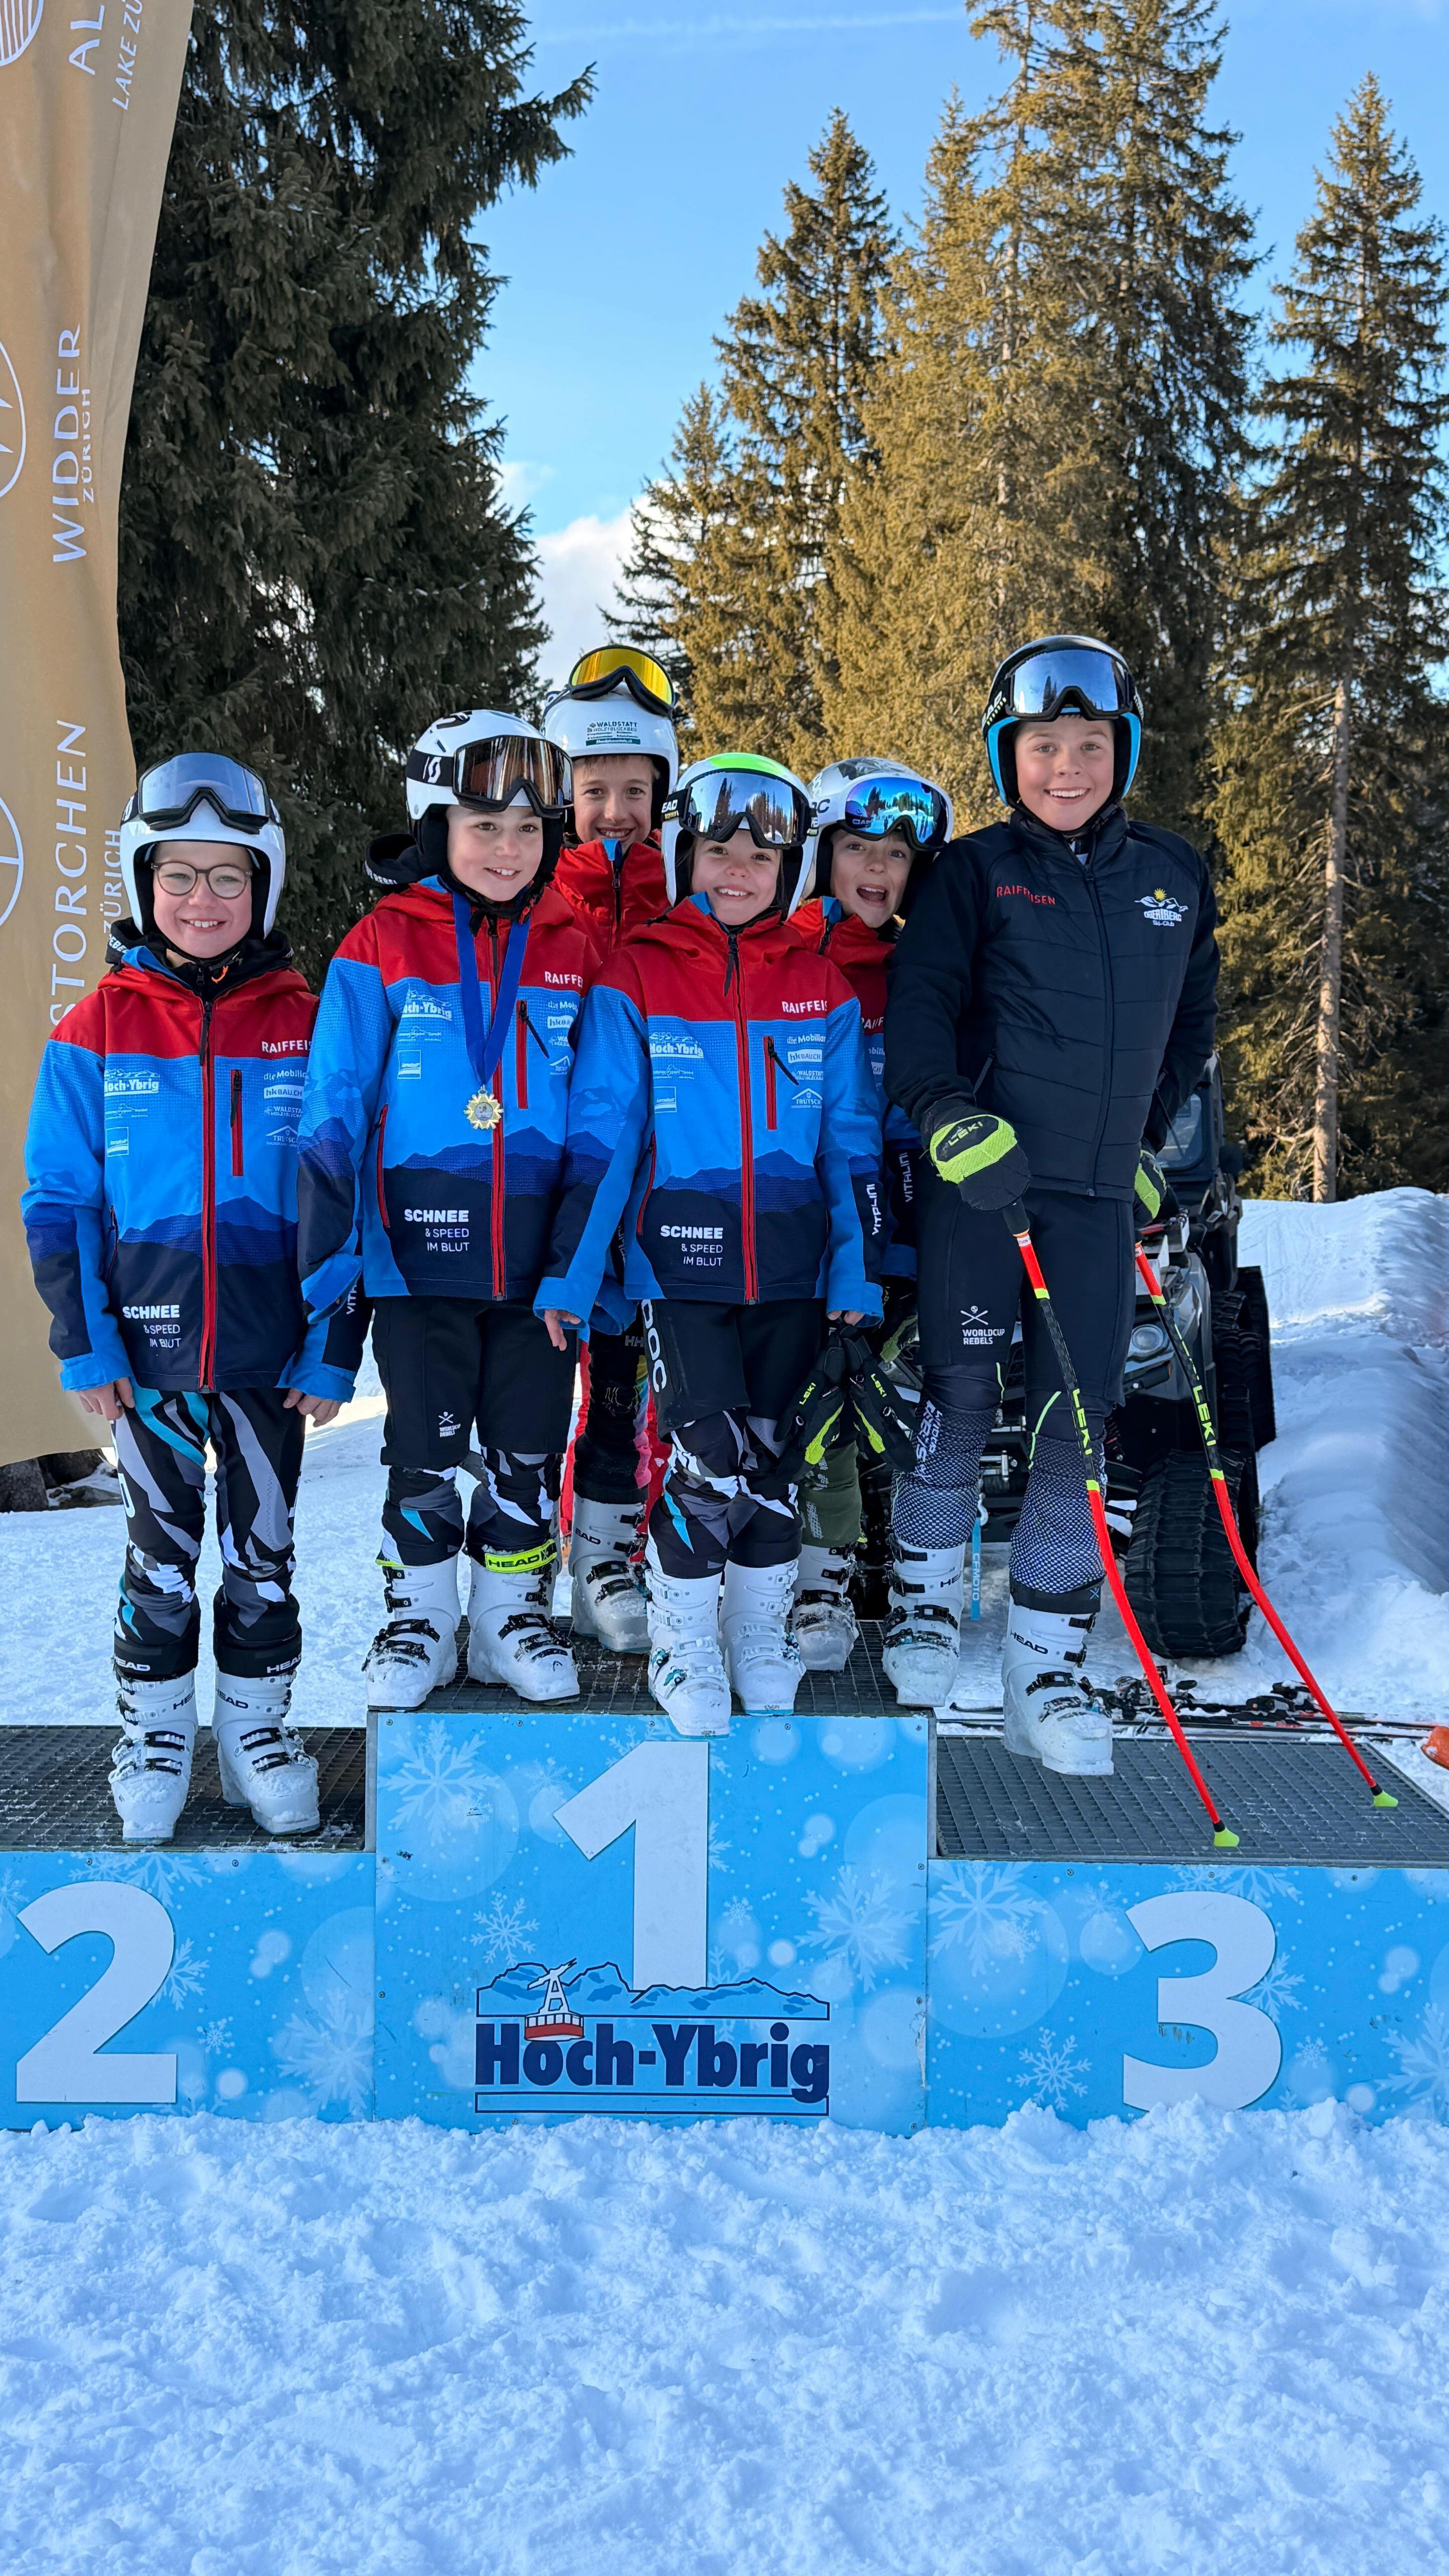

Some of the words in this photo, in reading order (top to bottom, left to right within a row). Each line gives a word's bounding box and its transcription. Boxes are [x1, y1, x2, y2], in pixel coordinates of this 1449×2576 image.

[112, 36, 137, 110] LAKE
[52, 324, 87, 562] WIDDER
[82, 389, 94, 503] ZÜRICH
[50, 719, 87, 1026] STORCHEN
[100, 830, 121, 933] ZÜRICH
[948, 1121, 983, 1146] LEKI
[404, 1209, 469, 1223] SCHNEE
[425, 1228, 431, 1237] &
[433, 1228, 469, 1238] SPEED
[660, 1225, 723, 1239] SCHNEE
[427, 1242, 438, 1251] IM
[441, 1242, 470, 1252] BLUT
[681, 1243, 687, 1252] &
[690, 1244, 723, 1253] SPEED
[683, 1256, 694, 1265] IM
[696, 1257, 723, 1266] BLUT
[122, 1305, 180, 1319] SCHNEE
[143, 1324, 149, 1334] &
[149, 1324, 181, 1334] SPEED
[962, 1329, 1005, 1337] WORLDCUP
[1073, 1388, 1093, 1455] LEKI
[1193, 1385, 1222, 1446] LEKI
[489, 1555, 540, 1568] HEAD
[972, 1553, 981, 1600] CFMOTO
[1010, 1628, 1049, 1654] HEAD
[552, 1741, 708, 1991] 1
[16, 1881, 177, 2103] 2
[1123, 1891, 1282, 2113] 3
[475, 2023, 830, 2103] Hoch-Ybrig
